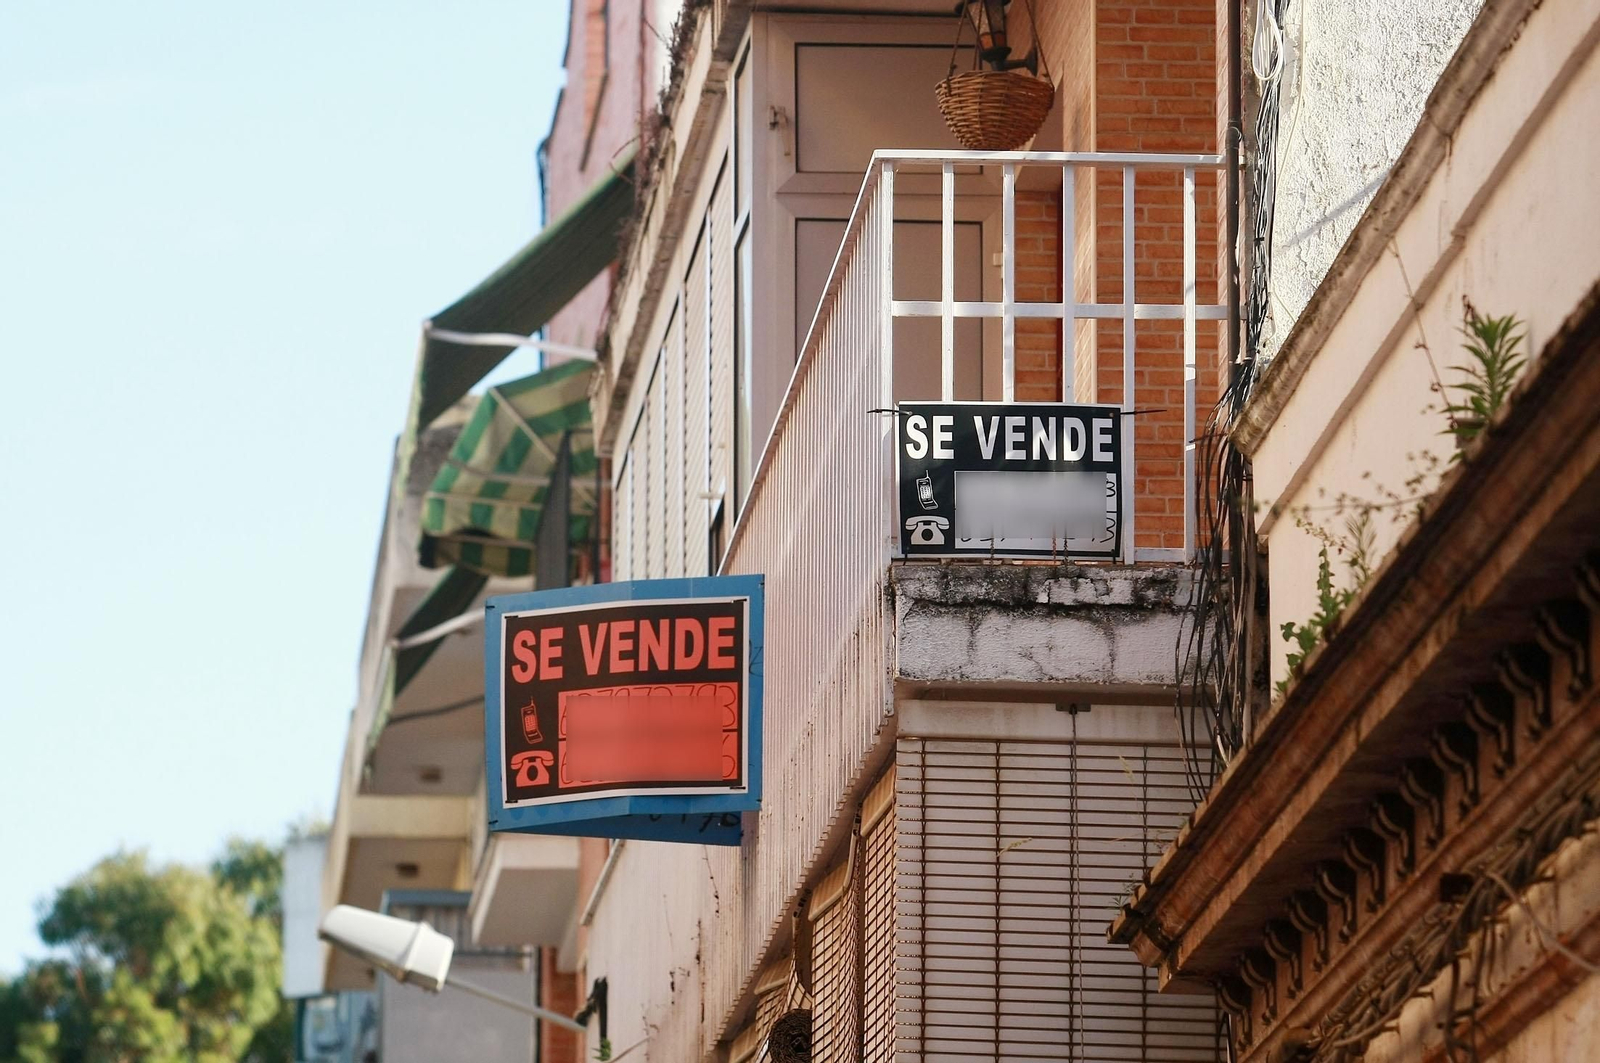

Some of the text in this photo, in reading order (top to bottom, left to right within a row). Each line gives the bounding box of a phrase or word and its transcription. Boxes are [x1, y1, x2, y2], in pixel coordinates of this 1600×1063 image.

[905, 415, 1114, 462] SE VENDE
[511, 627, 564, 684] SE
[578, 616, 736, 676] VENDE
